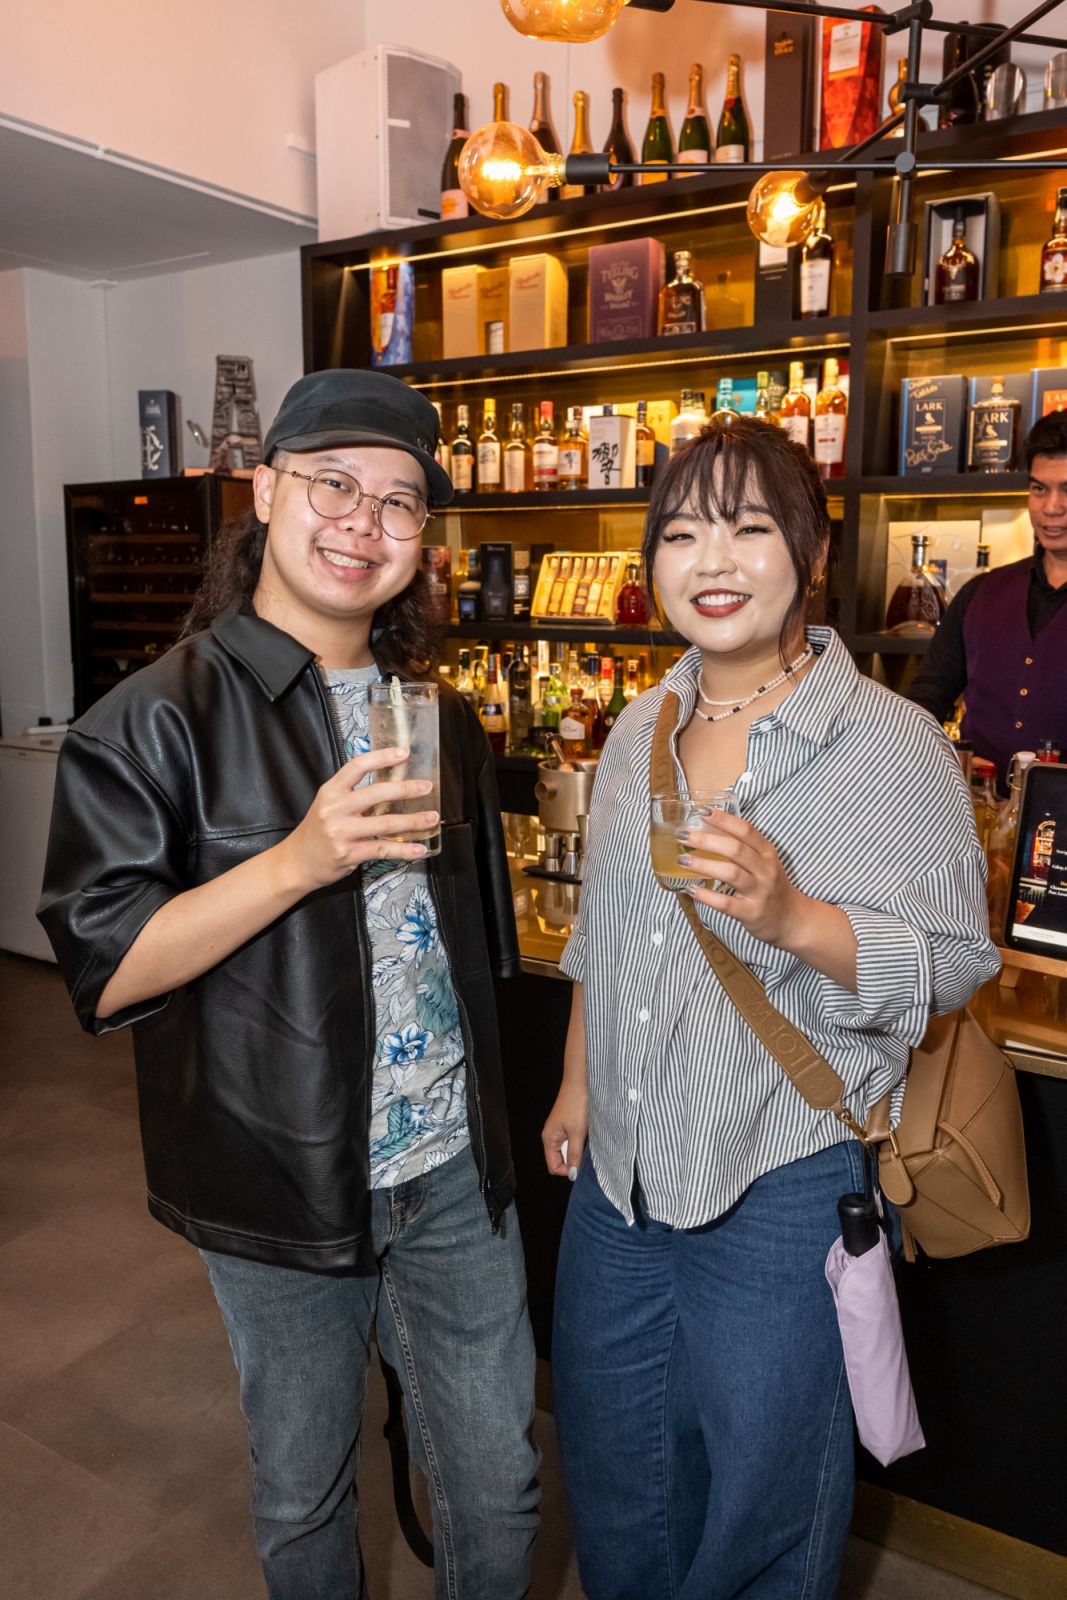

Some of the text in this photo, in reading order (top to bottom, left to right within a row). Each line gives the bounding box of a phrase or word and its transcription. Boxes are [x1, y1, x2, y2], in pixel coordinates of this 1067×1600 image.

[1047, 392, 1067, 404] LAR
[916, 402, 943, 411] LARK
[977, 412, 1009, 423] LARK
